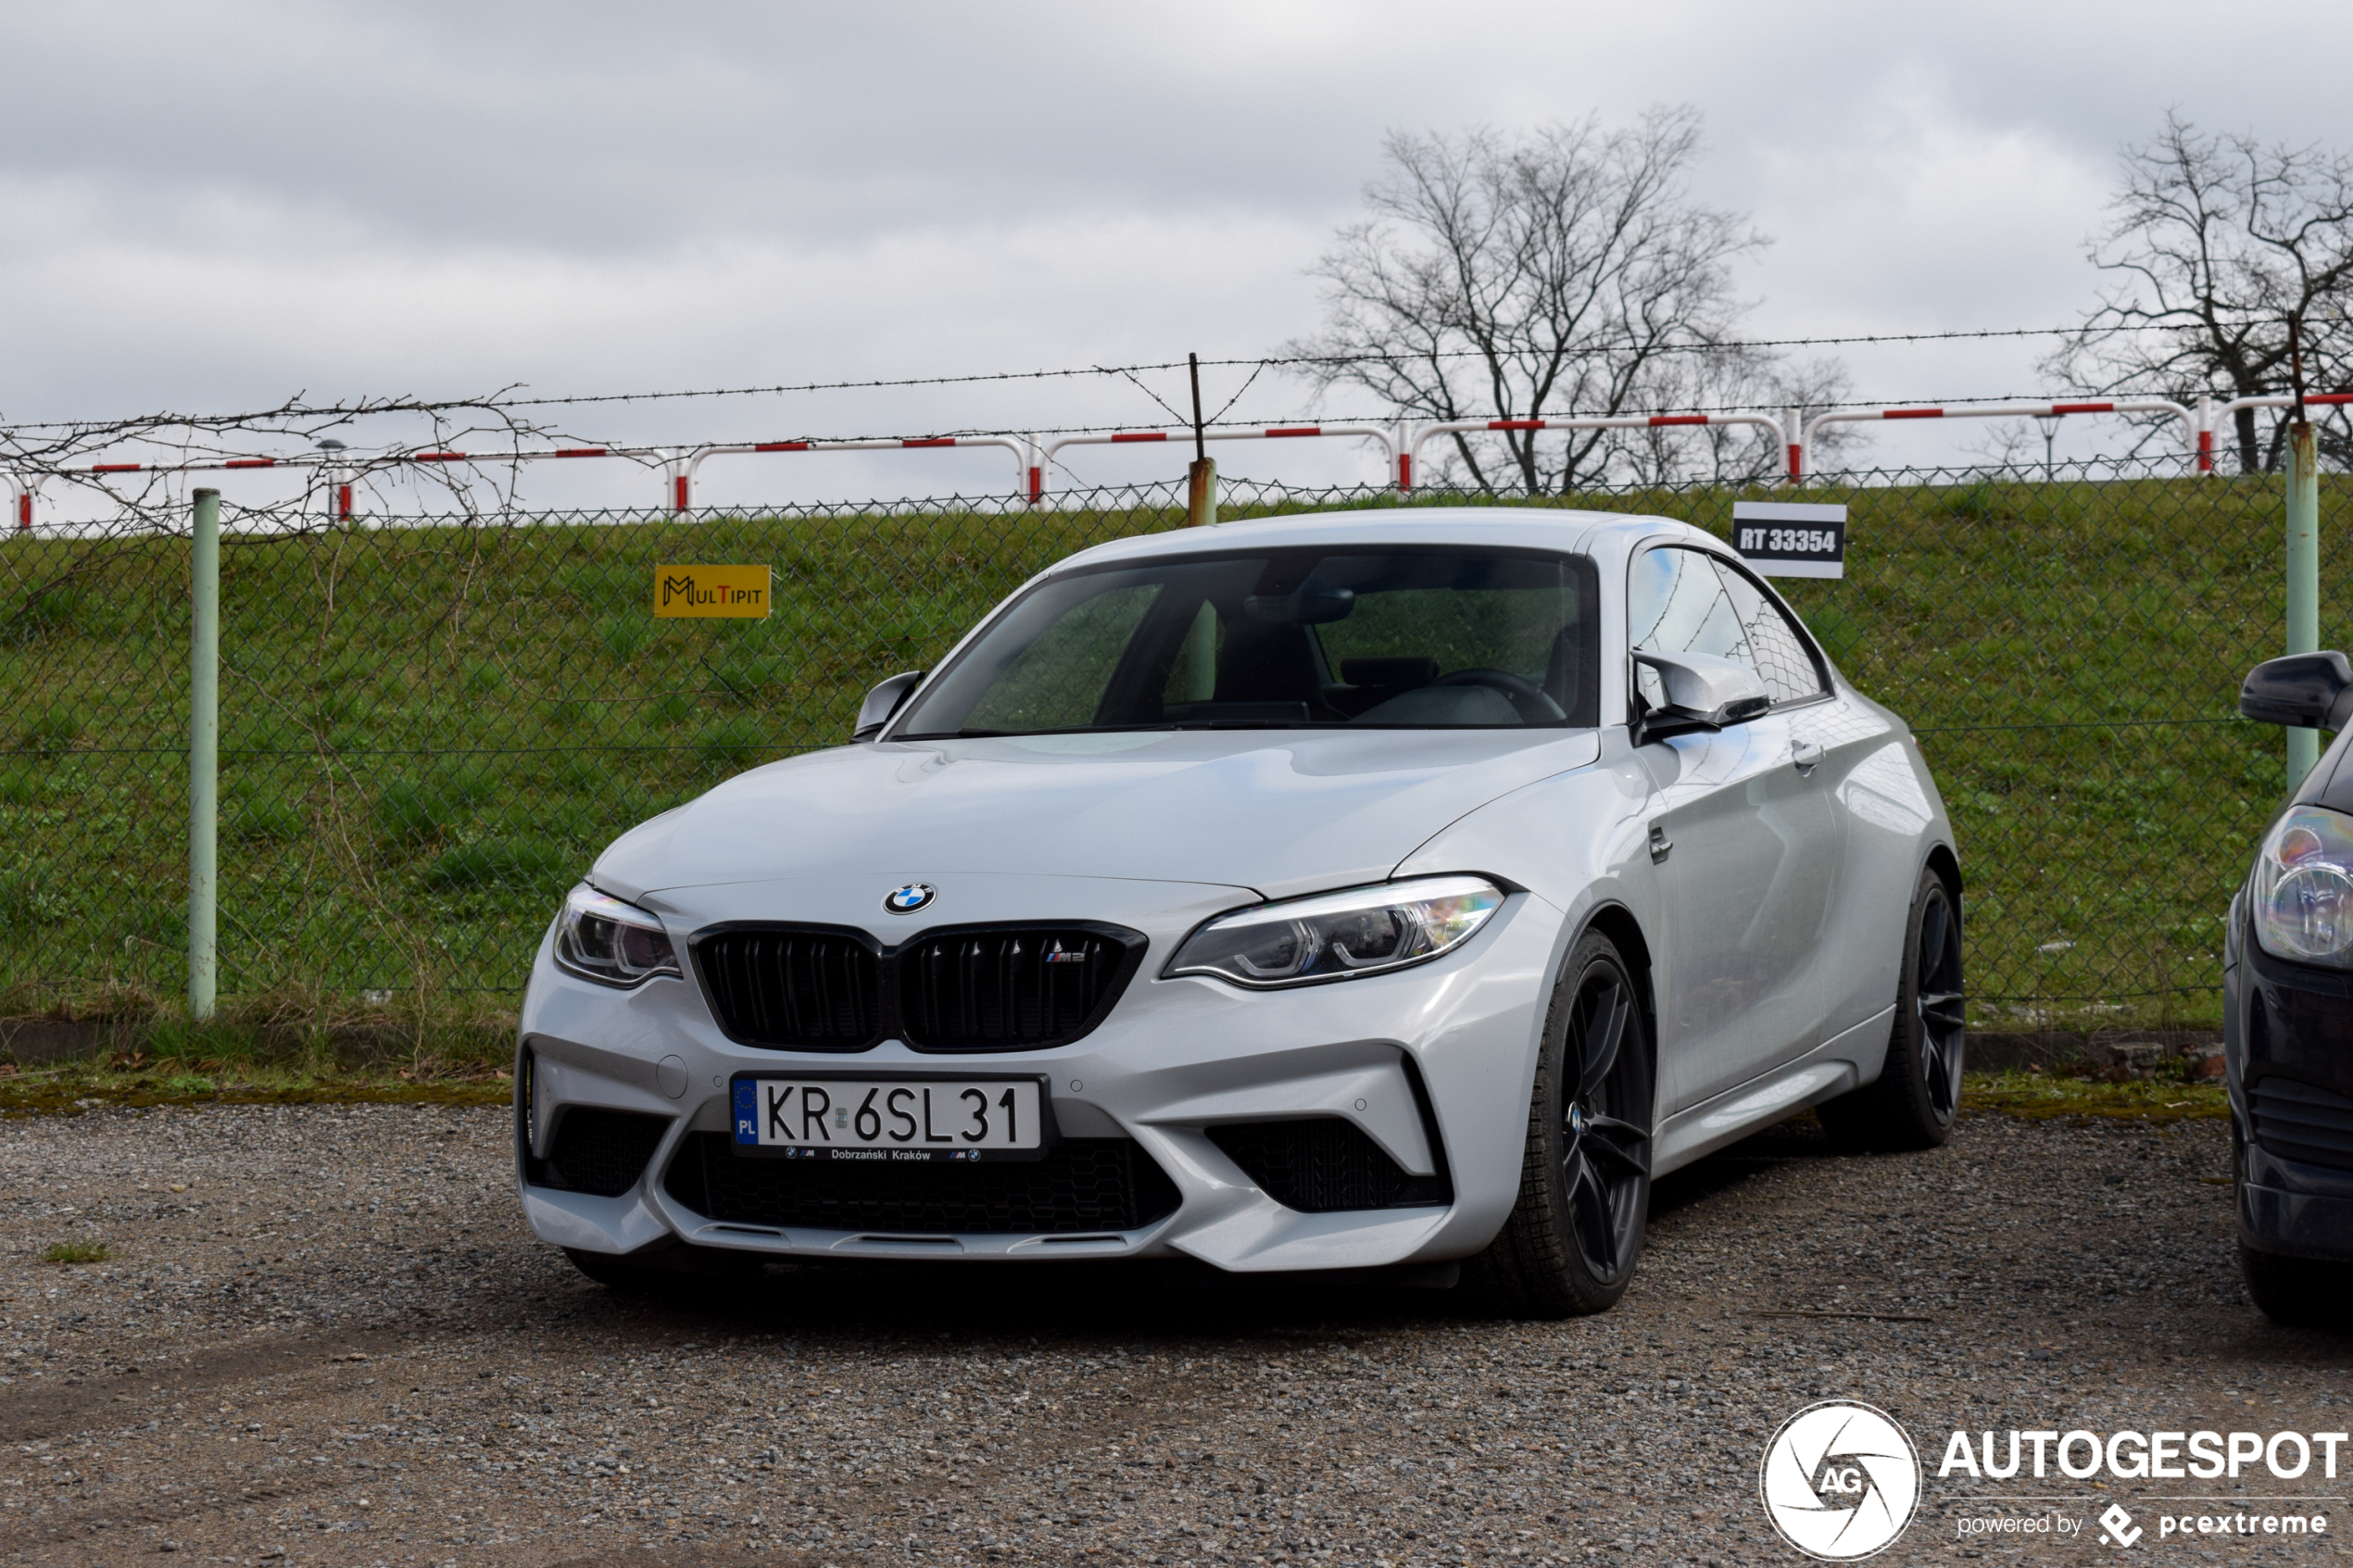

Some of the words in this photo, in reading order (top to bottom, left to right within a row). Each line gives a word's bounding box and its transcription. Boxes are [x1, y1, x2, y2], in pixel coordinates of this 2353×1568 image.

[1740, 528, 1767, 550] RT
[1768, 528, 1836, 553] 33354
[767, 1085, 832, 1141] KR
[854, 1086, 1018, 1143] 6SL31
[739, 1120, 756, 1135] PL
[831, 1148, 887, 1160] Dobrzański
[892, 1149, 930, 1160] Kraków
